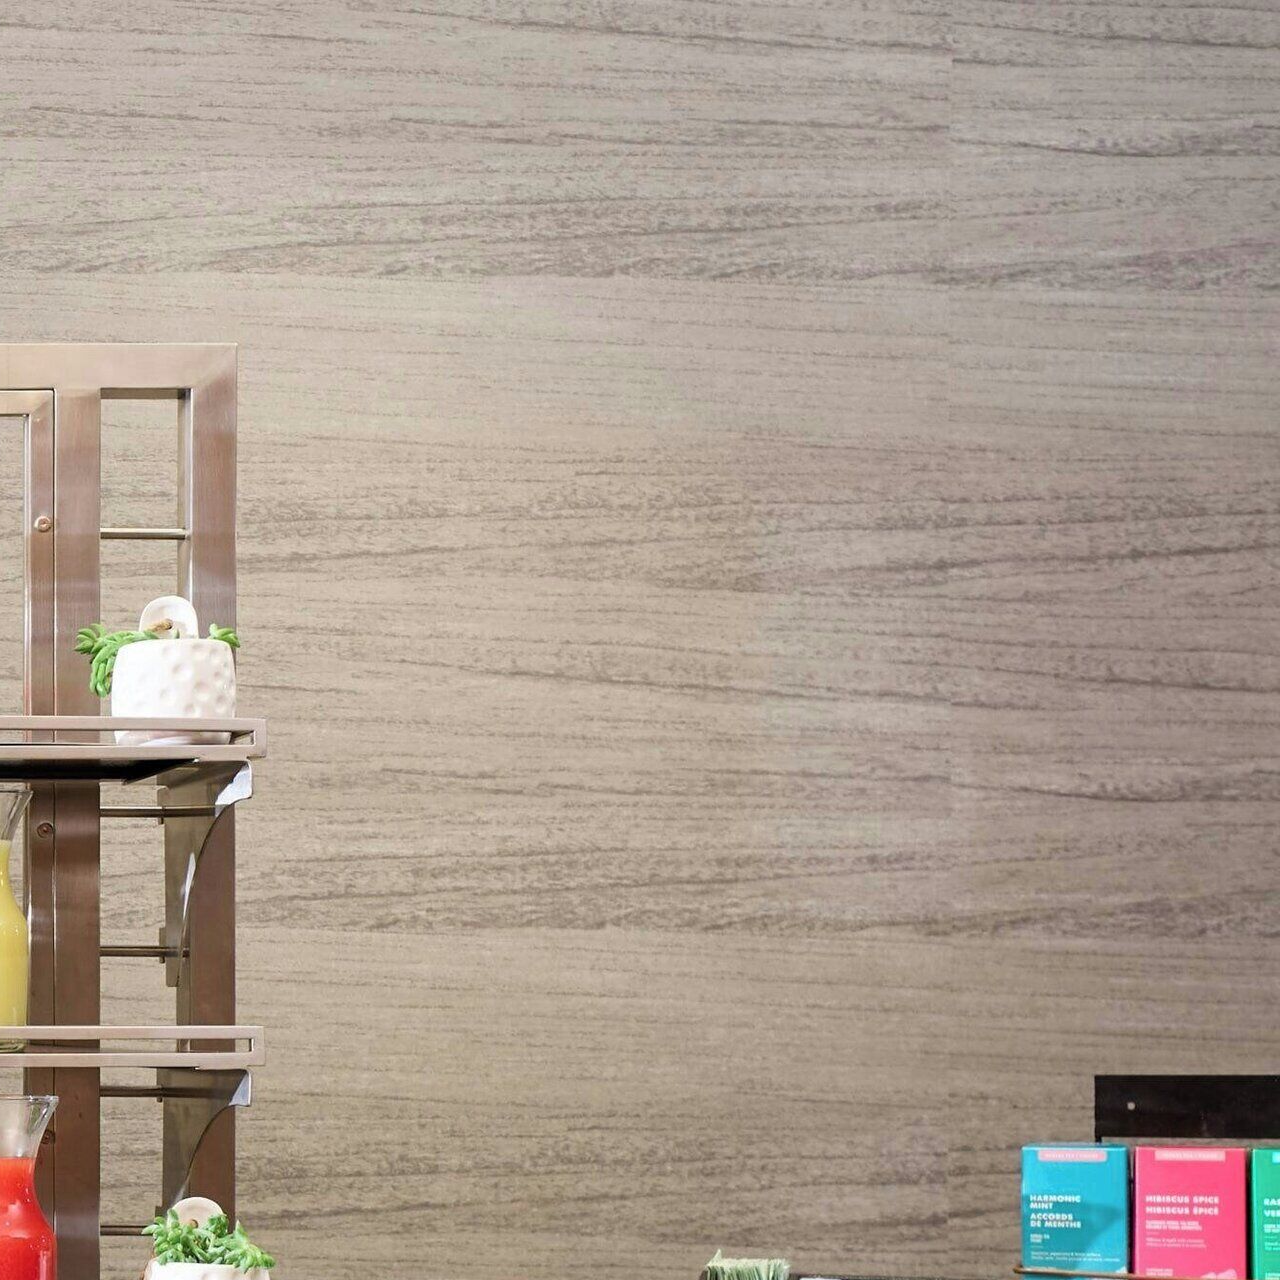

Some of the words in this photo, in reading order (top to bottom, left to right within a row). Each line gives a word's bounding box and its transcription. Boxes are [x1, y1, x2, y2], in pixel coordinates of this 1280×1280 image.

[1029, 1194, 1081, 1203] HARMONIC
[1145, 1195, 1190, 1204] HIBISCUS
[1193, 1195, 1219, 1204] SPICE
[1029, 1202, 1054, 1210] MINT
[1145, 1206, 1190, 1215] HIBISCUS
[1030, 1212, 1073, 1221] ACCORDS
[1030, 1220, 1042, 1228] DE
[1044, 1221, 1082, 1229] MENTHE
